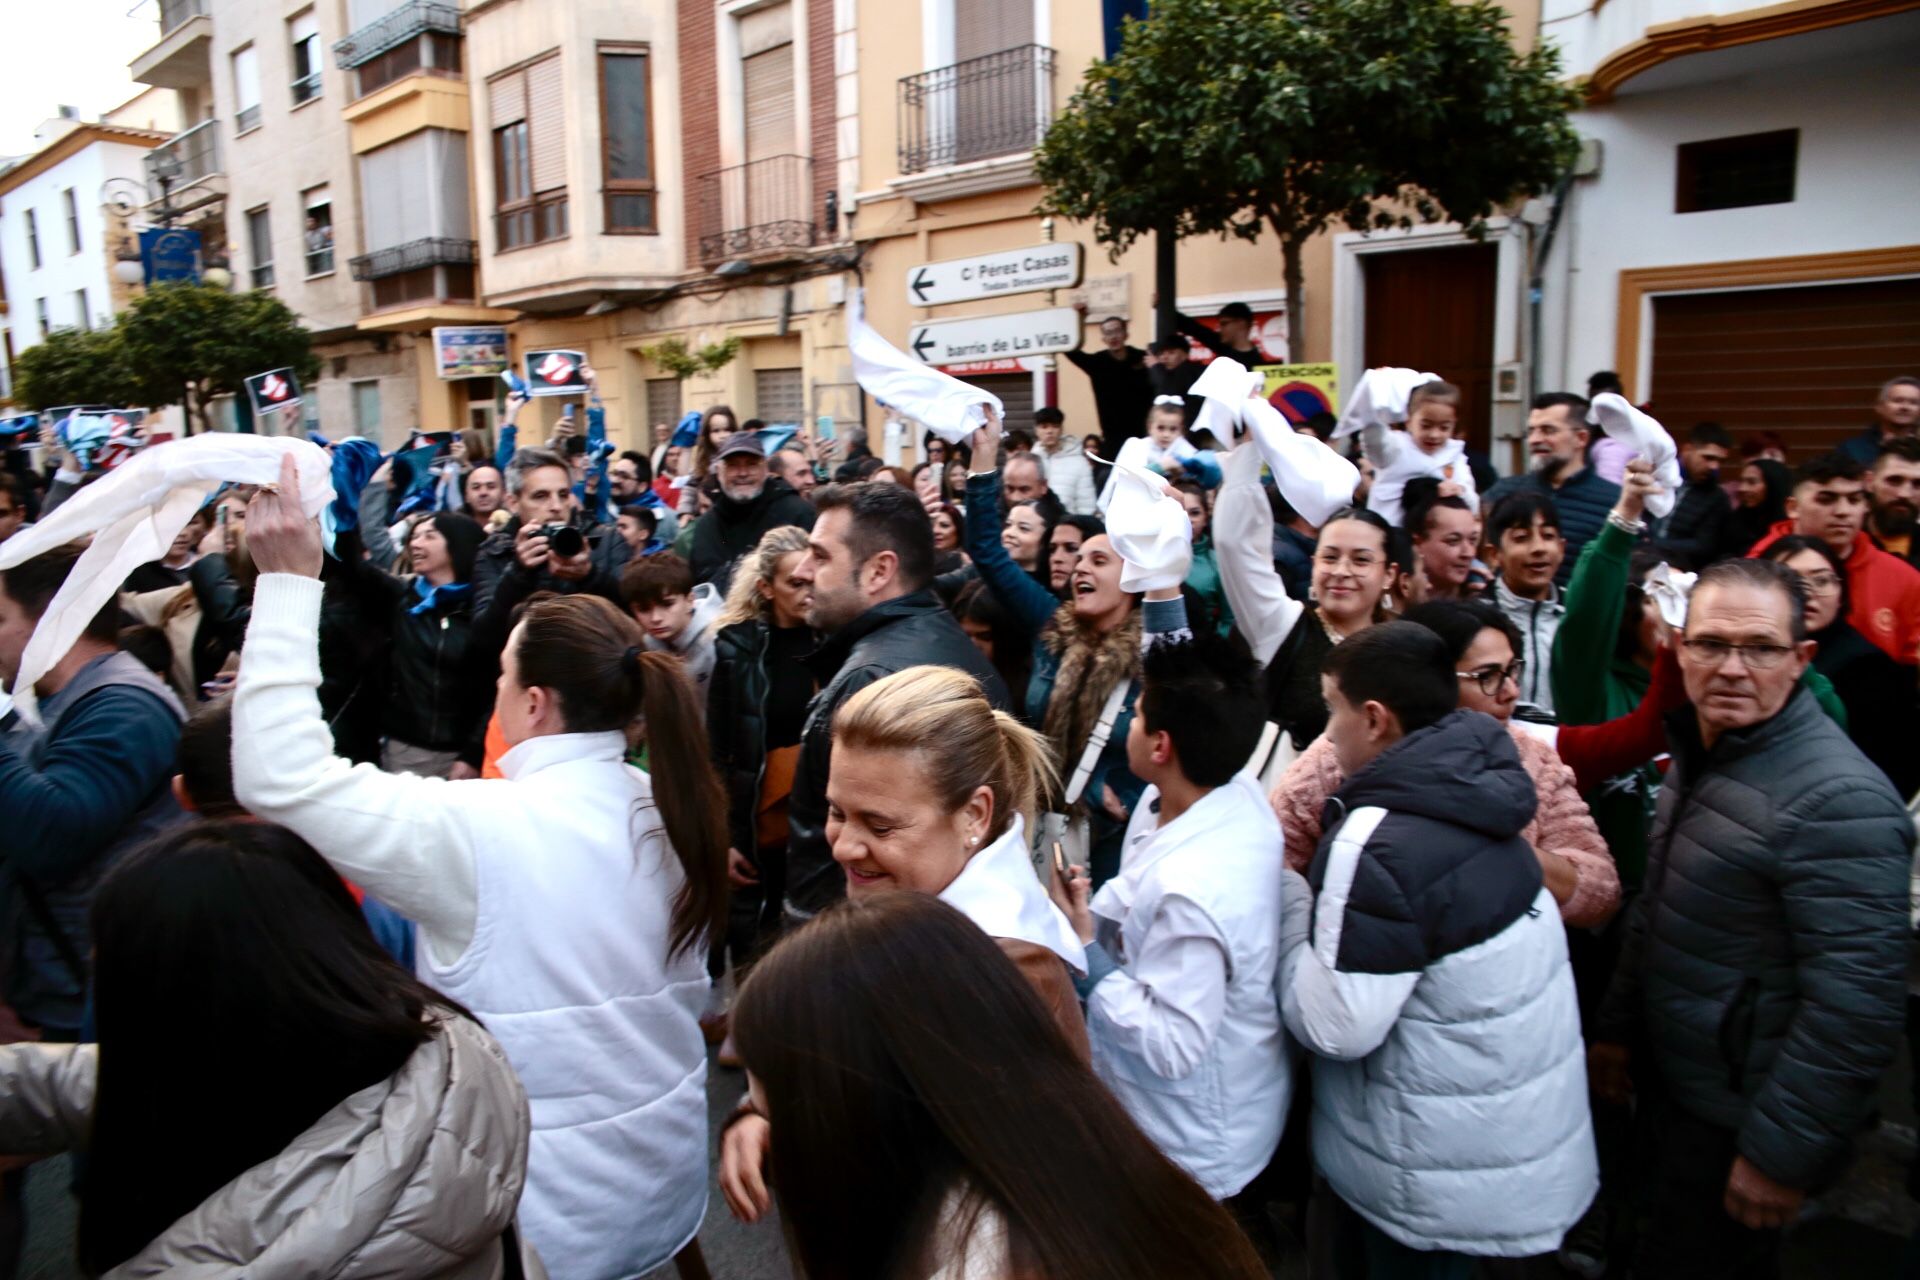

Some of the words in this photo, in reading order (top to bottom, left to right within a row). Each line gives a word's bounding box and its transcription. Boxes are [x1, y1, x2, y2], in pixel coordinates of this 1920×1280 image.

[1023, 254, 1068, 271] Casas
[946, 341, 986, 357] barrio
[992, 338, 1007, 352] de
[1014, 336, 1031, 350] La
[1035, 331, 1069, 346] Viña
